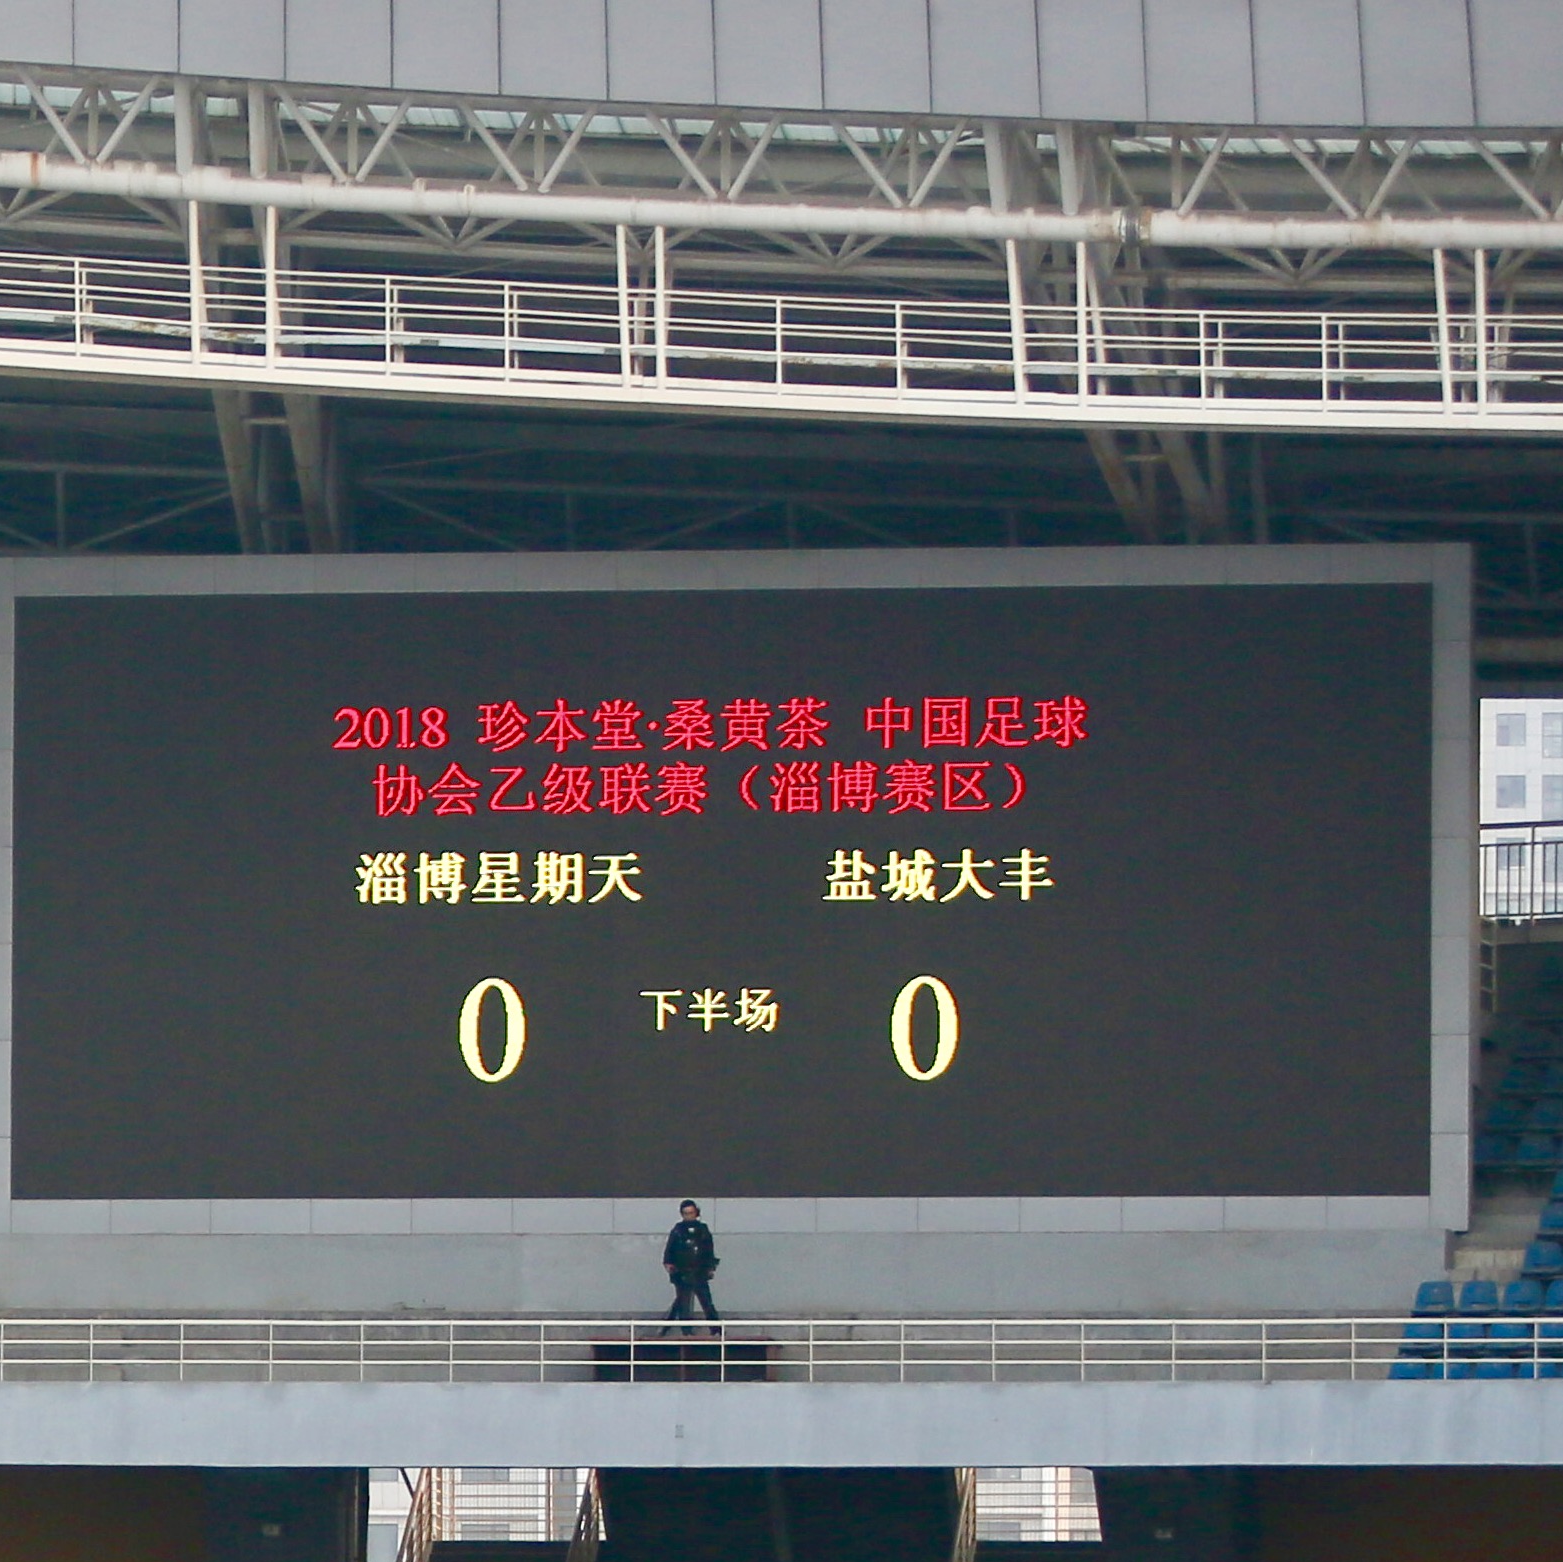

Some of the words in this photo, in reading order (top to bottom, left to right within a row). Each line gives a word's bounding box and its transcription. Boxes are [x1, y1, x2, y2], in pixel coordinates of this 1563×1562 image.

[332, 706, 448, 752] 2018
[477, 696, 830, 752] 珍本堂·桑黄茶
[863, 695, 1088, 749] 中国足球
[371, 761, 1027, 818] 协会乙级联赛（淄博赛区）
[355, 851, 643, 905] 淄博星期天
[822, 848, 1054, 903] 盐城大丰
[459, 977, 526, 1083] 0
[639, 987, 779, 1033] 下半场
[891, 975, 958, 1081] 0
